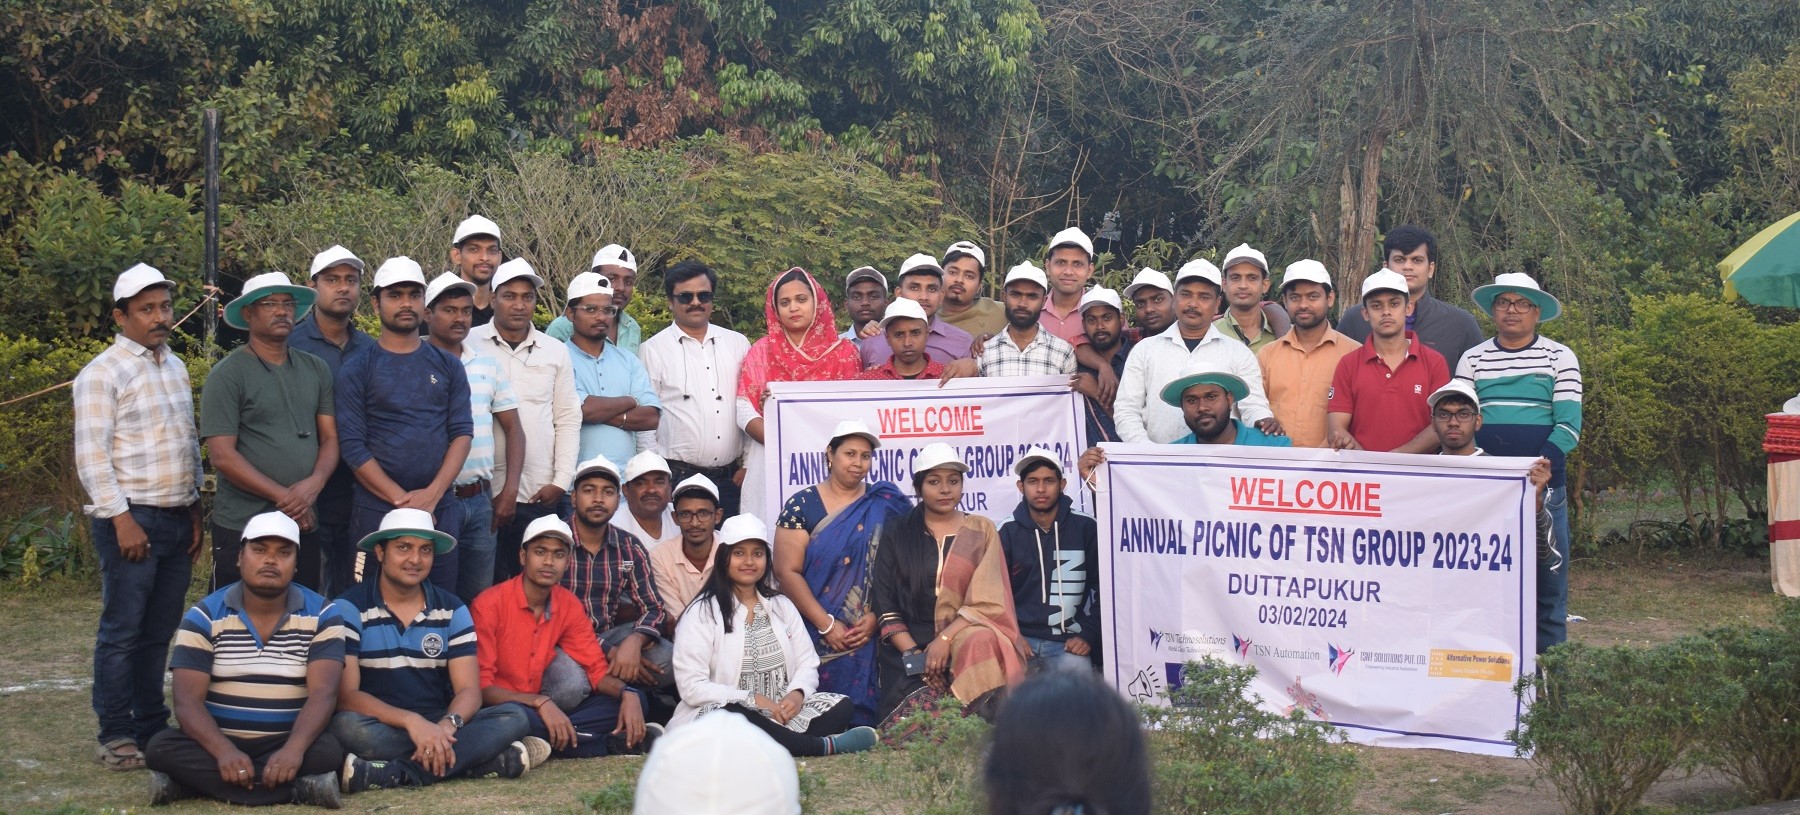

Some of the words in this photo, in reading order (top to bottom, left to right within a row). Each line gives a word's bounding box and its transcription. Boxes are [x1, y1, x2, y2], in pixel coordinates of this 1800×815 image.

[878, 405, 984, 433] WELCOME
[865, 448, 905, 482] CNIC
[964, 444, 1014, 479] GROUP
[1230, 477, 1383, 512] WELCOME
[1120, 517, 1187, 555] ANNUAL
[1193, 520, 1262, 559] PICNIC
[1269, 523, 1297, 560] OF
[1304, 526, 1345, 564] TSN
[1352, 528, 1426, 568] GROUP
[1432, 531, 1513, 572] 2023-24
[1228, 573, 1381, 603] DUTTAPUKUR
[1258, 604, 1347, 628] 03/02/2024
[1175, 632, 1227, 645] Technosolutions
[1253, 644, 1271, 657] TSN
[1273, 646, 1320, 661] Automation
[1374, 651, 1404, 664] SOLUTIONS
[1446, 653, 1472, 663] Alternative
[1473, 655, 1488, 664] Power
[1488, 655, 1511, 665] Solutions
